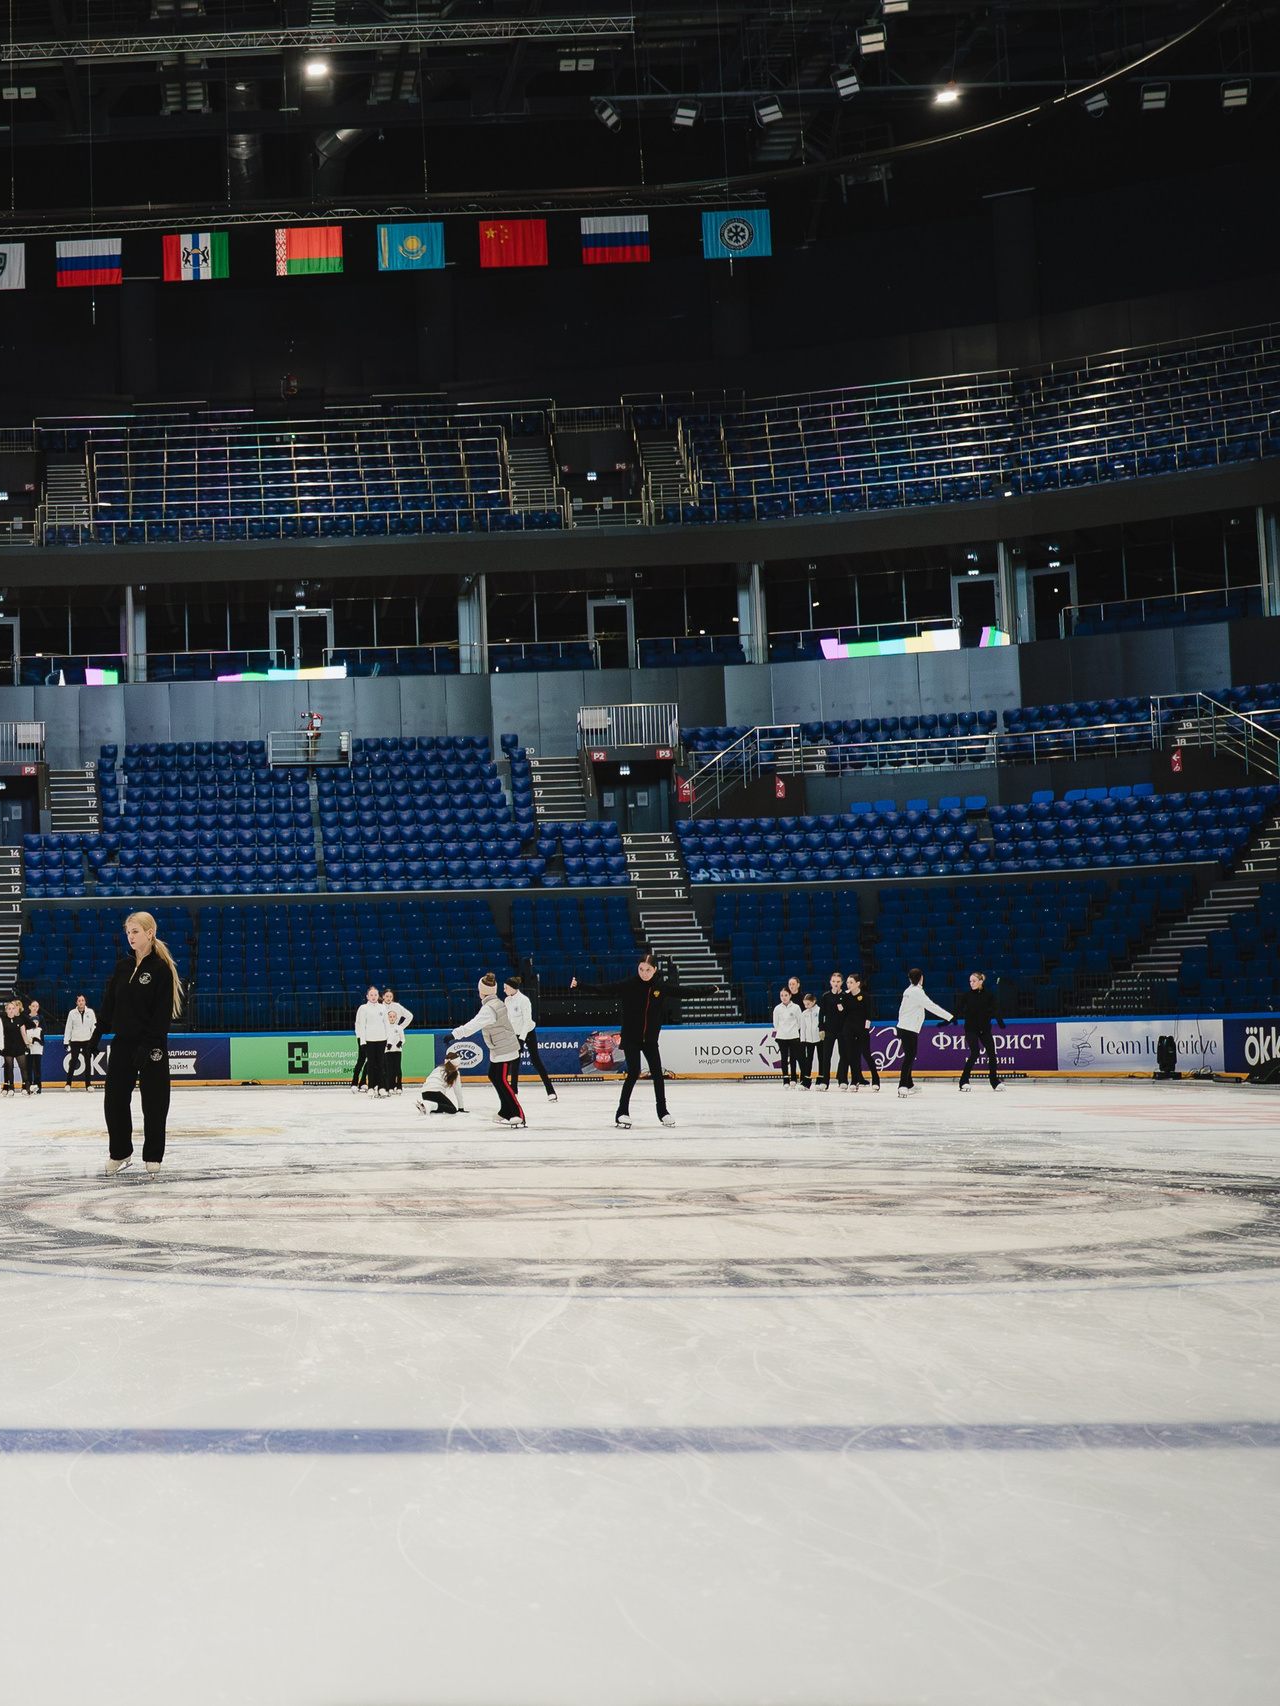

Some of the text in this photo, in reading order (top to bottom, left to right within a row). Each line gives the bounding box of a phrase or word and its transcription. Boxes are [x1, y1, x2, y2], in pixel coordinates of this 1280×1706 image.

[593, 752, 605, 760] P2
[659, 749, 671, 758] P3
[85, 761, 96, 769] 20
[24, 766, 36, 774] P2
[534, 790, 543, 798] 17
[88, 800, 97, 808] 17
[661, 835, 670, 843] 14
[1260, 841, 1270, 849] 12
[10, 849, 19, 857] 14
[626, 854, 636, 862] 13
[11, 867, 20, 875] 13
[1245, 863, 1254, 871] 11
[630, 872, 640, 880] 12
[669, 871, 679, 879] 12
[1100, 1036, 1141, 1056] Team
[460, 1050, 470, 1059] SC
[694, 1045, 754, 1056] INDOOR
